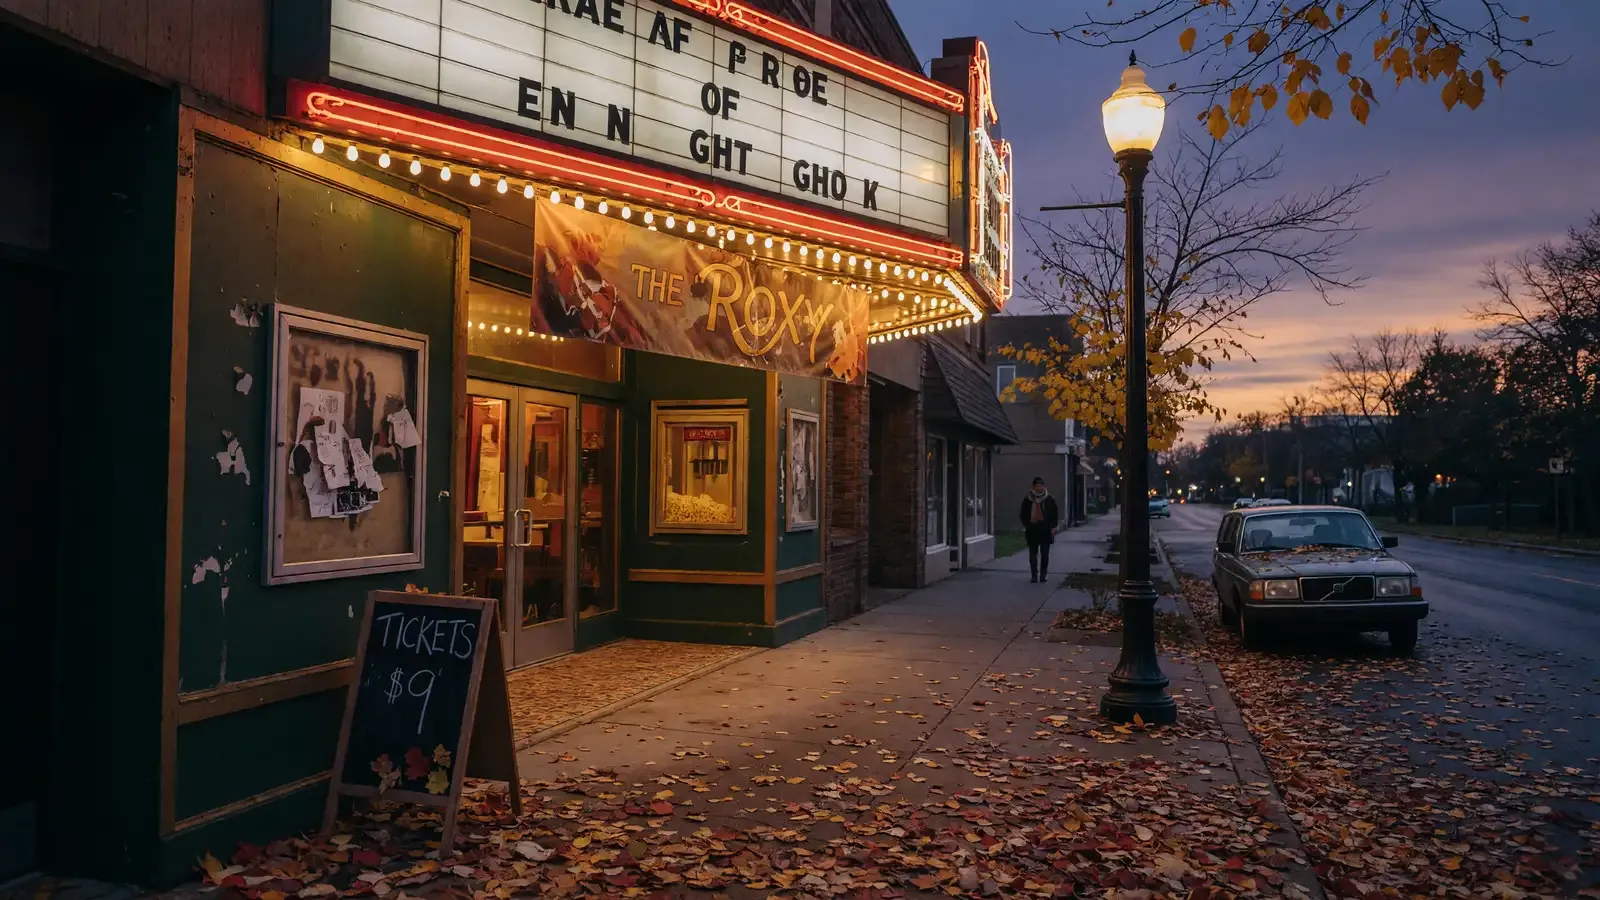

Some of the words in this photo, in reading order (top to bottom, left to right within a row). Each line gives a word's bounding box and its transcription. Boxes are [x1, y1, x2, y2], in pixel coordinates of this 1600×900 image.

[648, 10, 692, 54] AF
[701, 82, 740, 120] OF
[690, 129, 753, 175] GHT
[631, 263, 684, 307] THE
[376, 612, 476, 659] TICKETS
